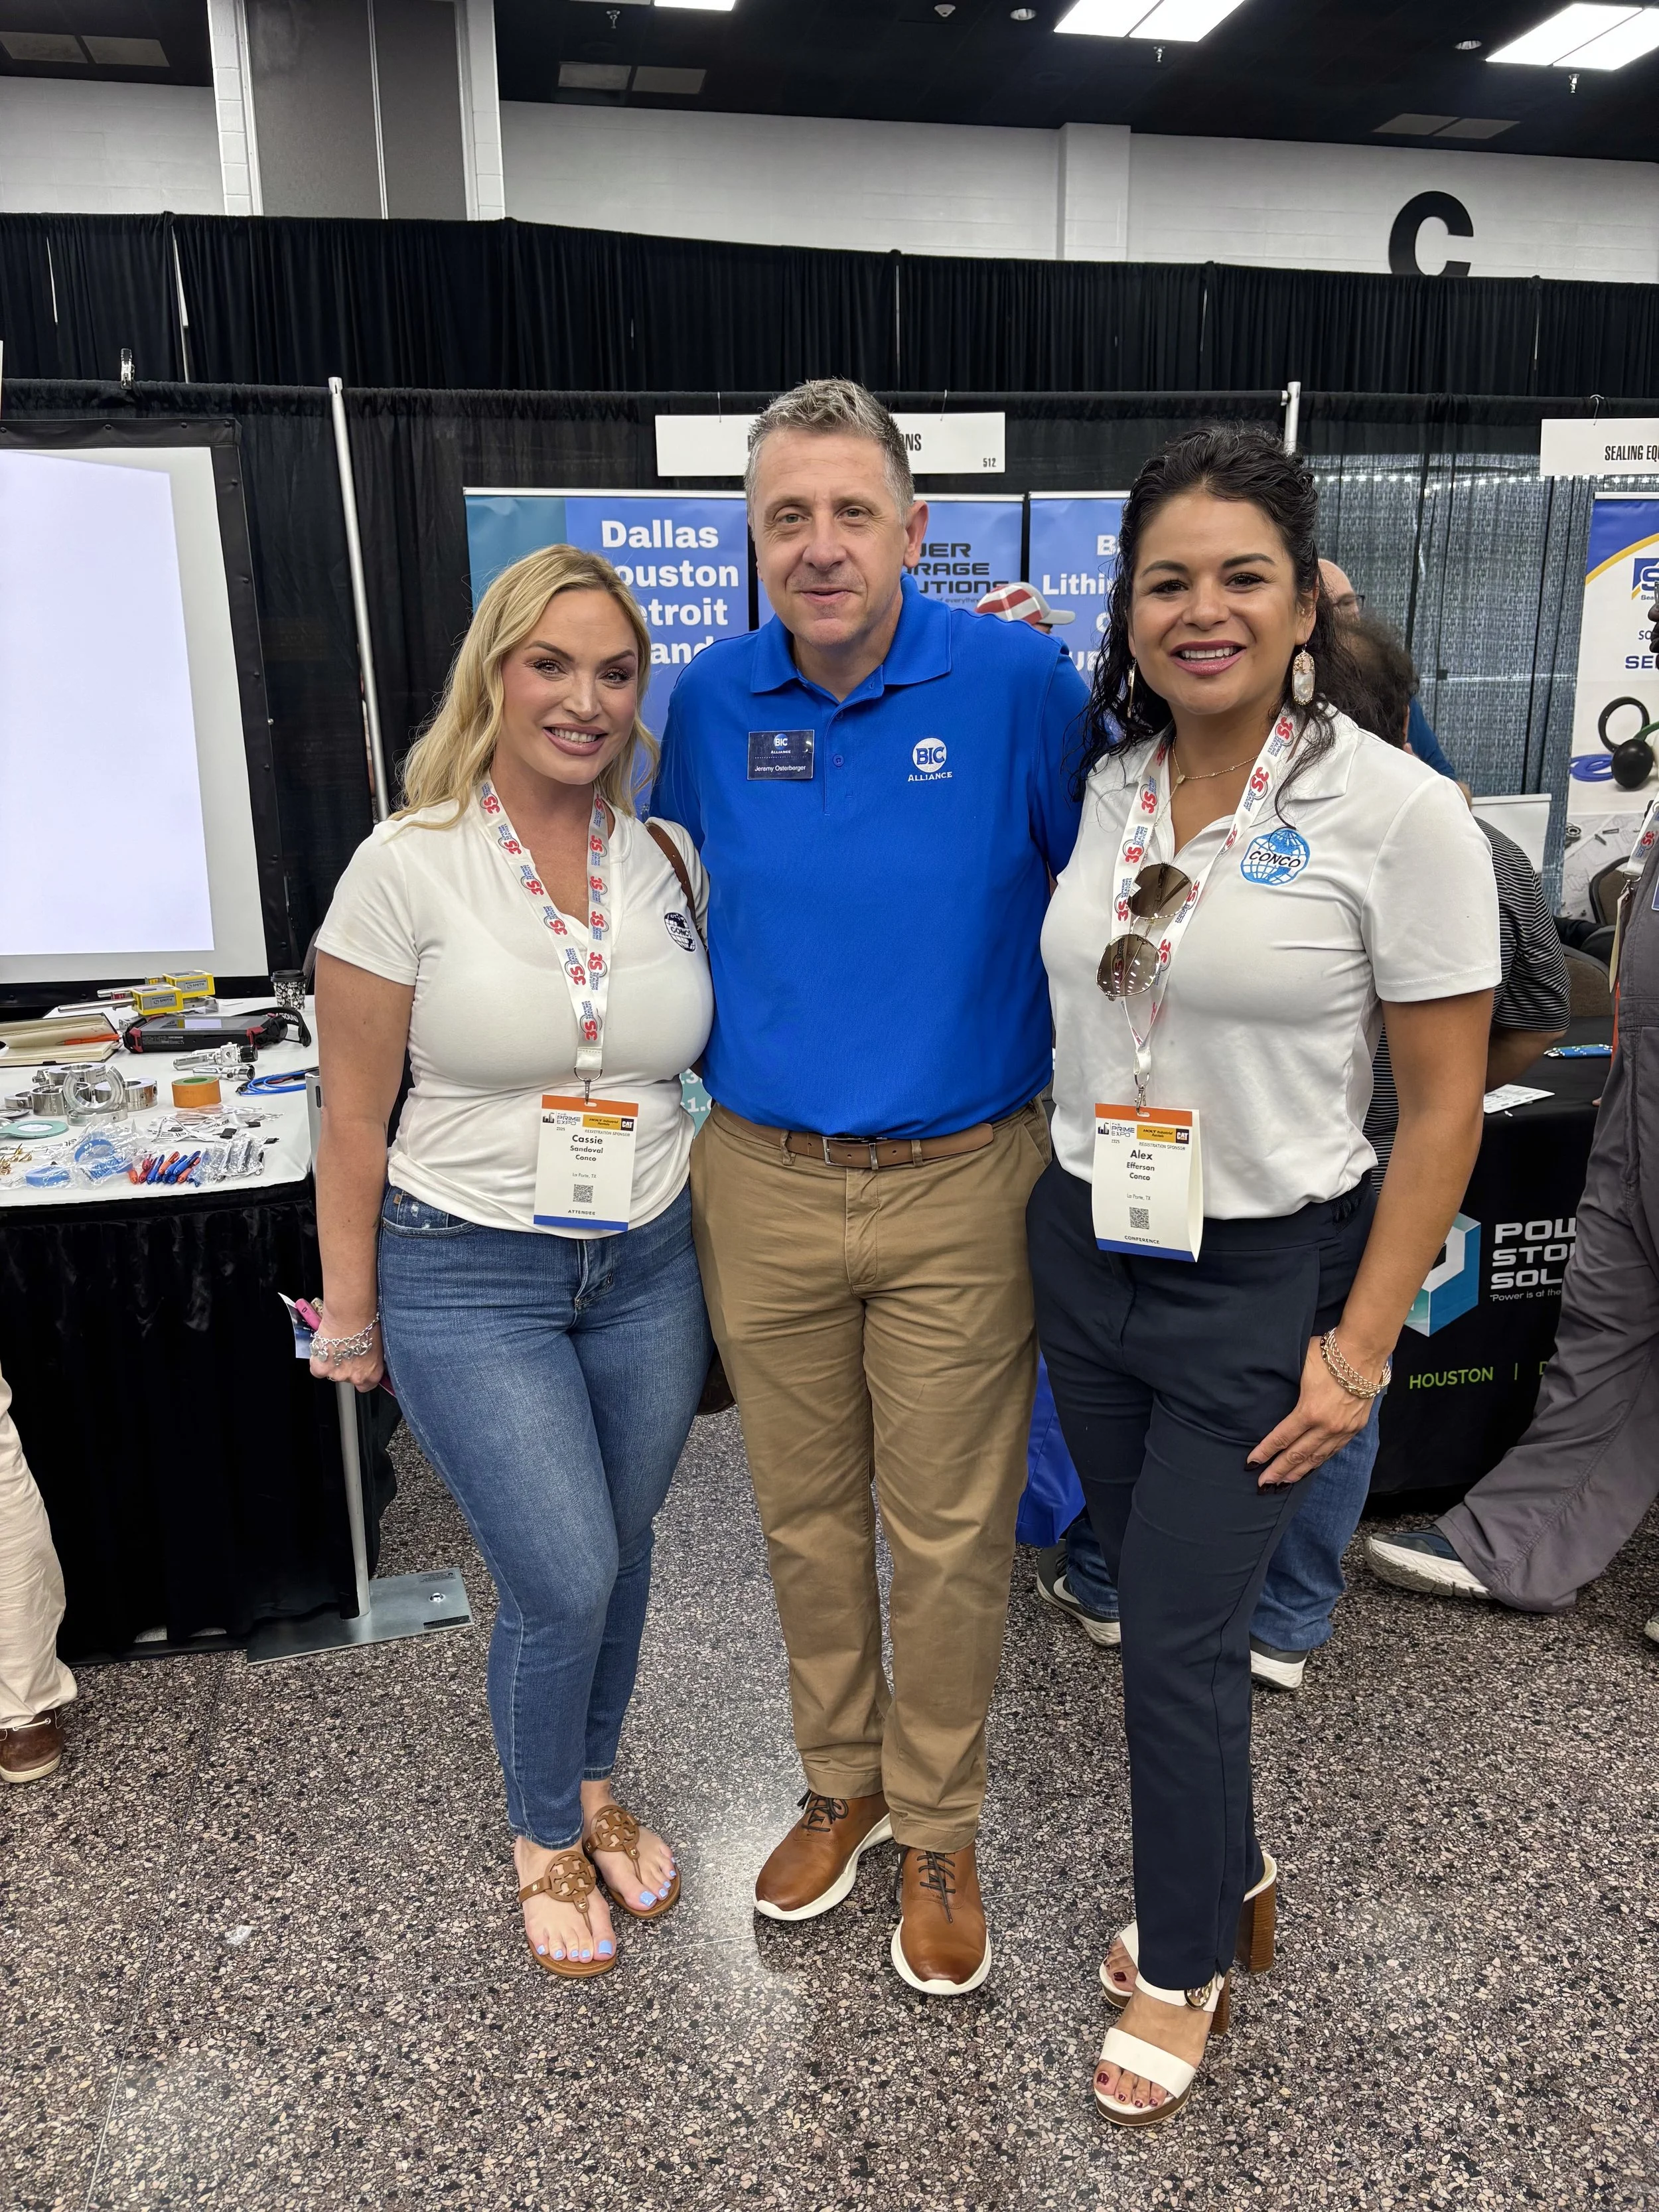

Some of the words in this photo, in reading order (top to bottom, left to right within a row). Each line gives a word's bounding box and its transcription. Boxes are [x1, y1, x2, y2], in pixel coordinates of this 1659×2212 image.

[1389, 191, 1473, 277] C
[983, 457, 997, 467] 512
[1605, 445, 1644, 461] SEALING
[1646, 445, 1659, 462] EQ
[601, 519, 719, 548] Dallas
[614, 559, 739, 587] ouston
[907, 563, 989, 575] RAGE
[1043, 573, 1110, 595] Lithi
[640, 597, 728, 626] troit
[1625, 656, 1656, 669] SE
[1277, 717, 1293, 739] 3S
[916, 747, 945, 765] BIC
[908, 771, 952, 782] ALLIANCE
[1252, 767, 1269, 792] 3S
[484, 796, 500, 814] 3S
[1141, 790, 1157, 814] 3S
[504, 840, 522, 854] 3S
[591, 835, 603, 852] 3S
[1125, 846, 1142, 863] 3S
[1250, 851, 1301, 867] CONCO
[526, 880, 544, 895] 3S
[591, 876, 603, 890] 3S
[549, 920, 568, 935] 3S
[591, 911, 604, 927] 3S
[590, 952, 603, 970] 3S
[570, 966, 586, 986] 3S
[585, 1020, 598, 1041] 3S
[572, 1135, 603, 1144] Cassie
[1177, 1132, 1188, 1140] CAT
[1130, 1149, 1153, 1160] Alex
[1127, 1162, 1155, 1171] Efferson
[1494, 1217, 1577, 1244] POW
[1124, 1235, 1160, 1244] CONFERENCE
[1492, 1242, 1575, 1267] STO
[1490, 1268, 1563, 1290] SOL
[1409, 1366, 1493, 1389] HOUSTON
[1539, 1361, 1548, 1375] D
